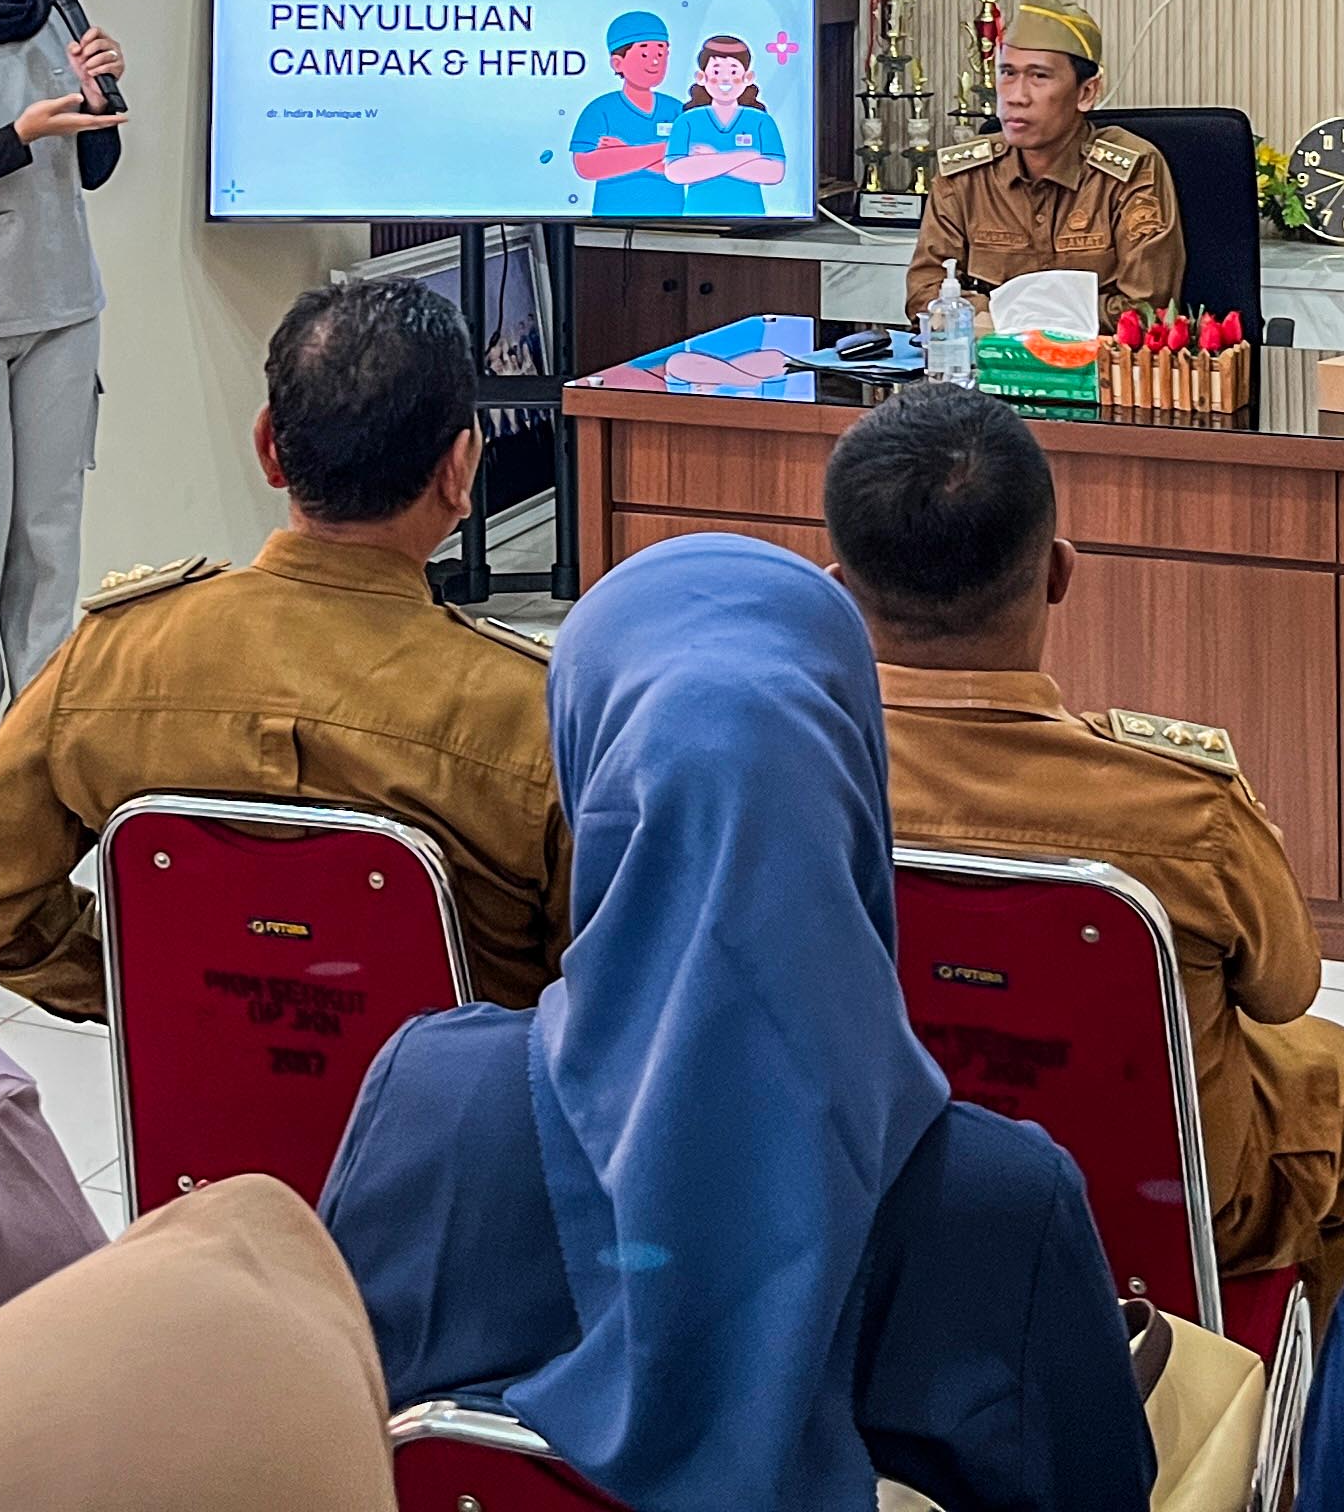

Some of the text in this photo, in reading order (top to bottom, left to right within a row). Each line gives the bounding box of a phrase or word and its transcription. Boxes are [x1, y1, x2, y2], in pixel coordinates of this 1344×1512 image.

[270, 3, 532, 32] PENYULUHAN
[269, 48, 587, 76] CAMPAK & HFMD
[364, 108, 379, 119] W
[1304, 151, 1321, 167] 10
[1297, 172, 1310, 188] 9
[1304, 193, 1317, 210] 8
[1320, 208, 1333, 226] 7
